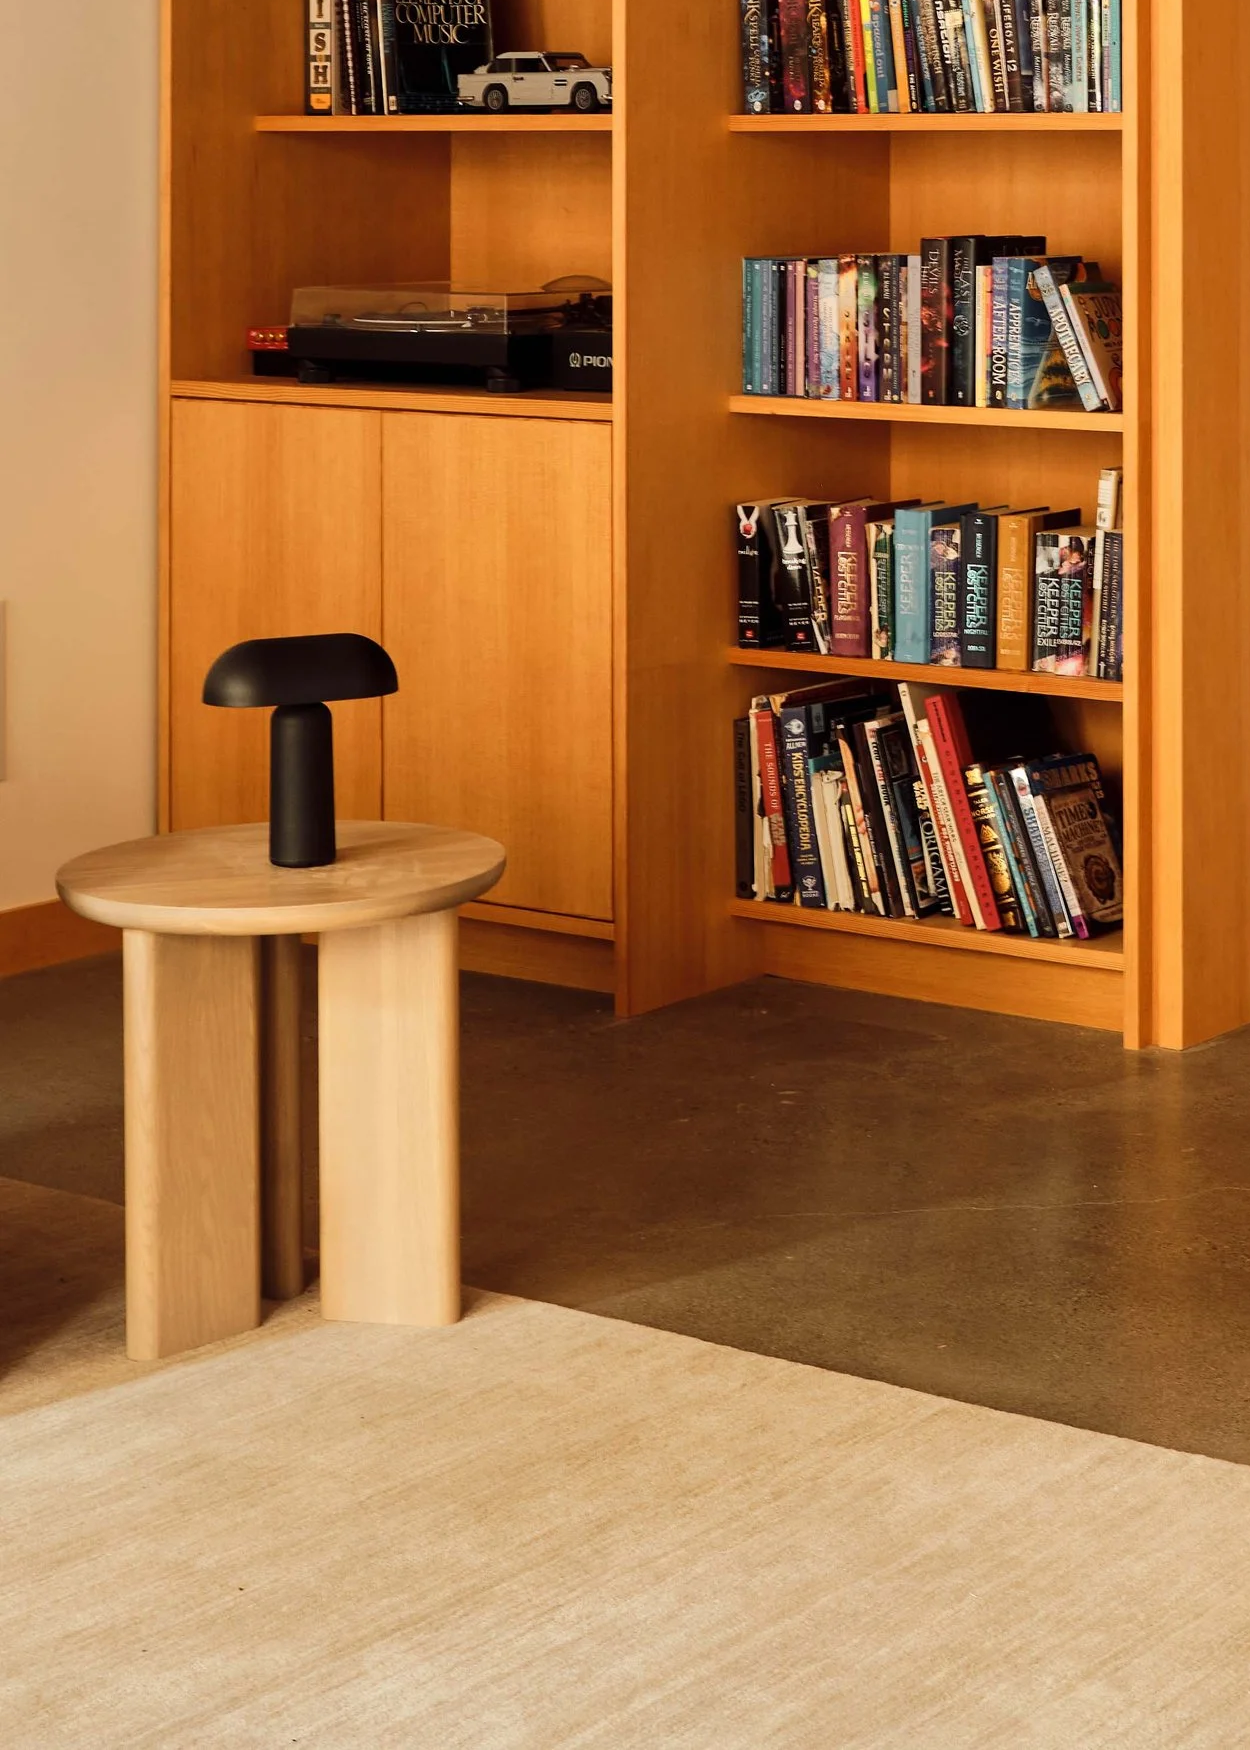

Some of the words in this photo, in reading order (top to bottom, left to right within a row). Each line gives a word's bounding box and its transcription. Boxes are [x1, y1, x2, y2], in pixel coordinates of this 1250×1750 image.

[395, 5, 488, 24] COMPUTER
[414, 24, 468, 44] MUSIC
[871, 14, 883, 56] spaced
[989, 28, 1001, 56] ONE
[993, 59, 1004, 93] WISH
[1007, 59, 1017, 72] 12
[1049, 307, 1090, 385] APOTHECARY
[935, 571, 945, 598] LOST
[943, 571, 957, 629] KEEPER
[1038, 576, 1048, 603] LOST
[1060, 577, 1070, 604] LOST
[934, 600, 945, 631] CITIES
[1037, 605, 1048, 637] CITIES
[1046, 577, 1060, 636] KEEPER
[1060, 605, 1070, 638] CITIES
[1068, 578, 1082, 638] KEEPER
[763, 742, 772, 759] THE
[767, 762, 776, 797] SOUNDS
[771, 799, 779, 810] OF
[793, 779, 811, 850] ENCYCLOPEDIA
[922, 820, 947, 899] ORIGAMI
